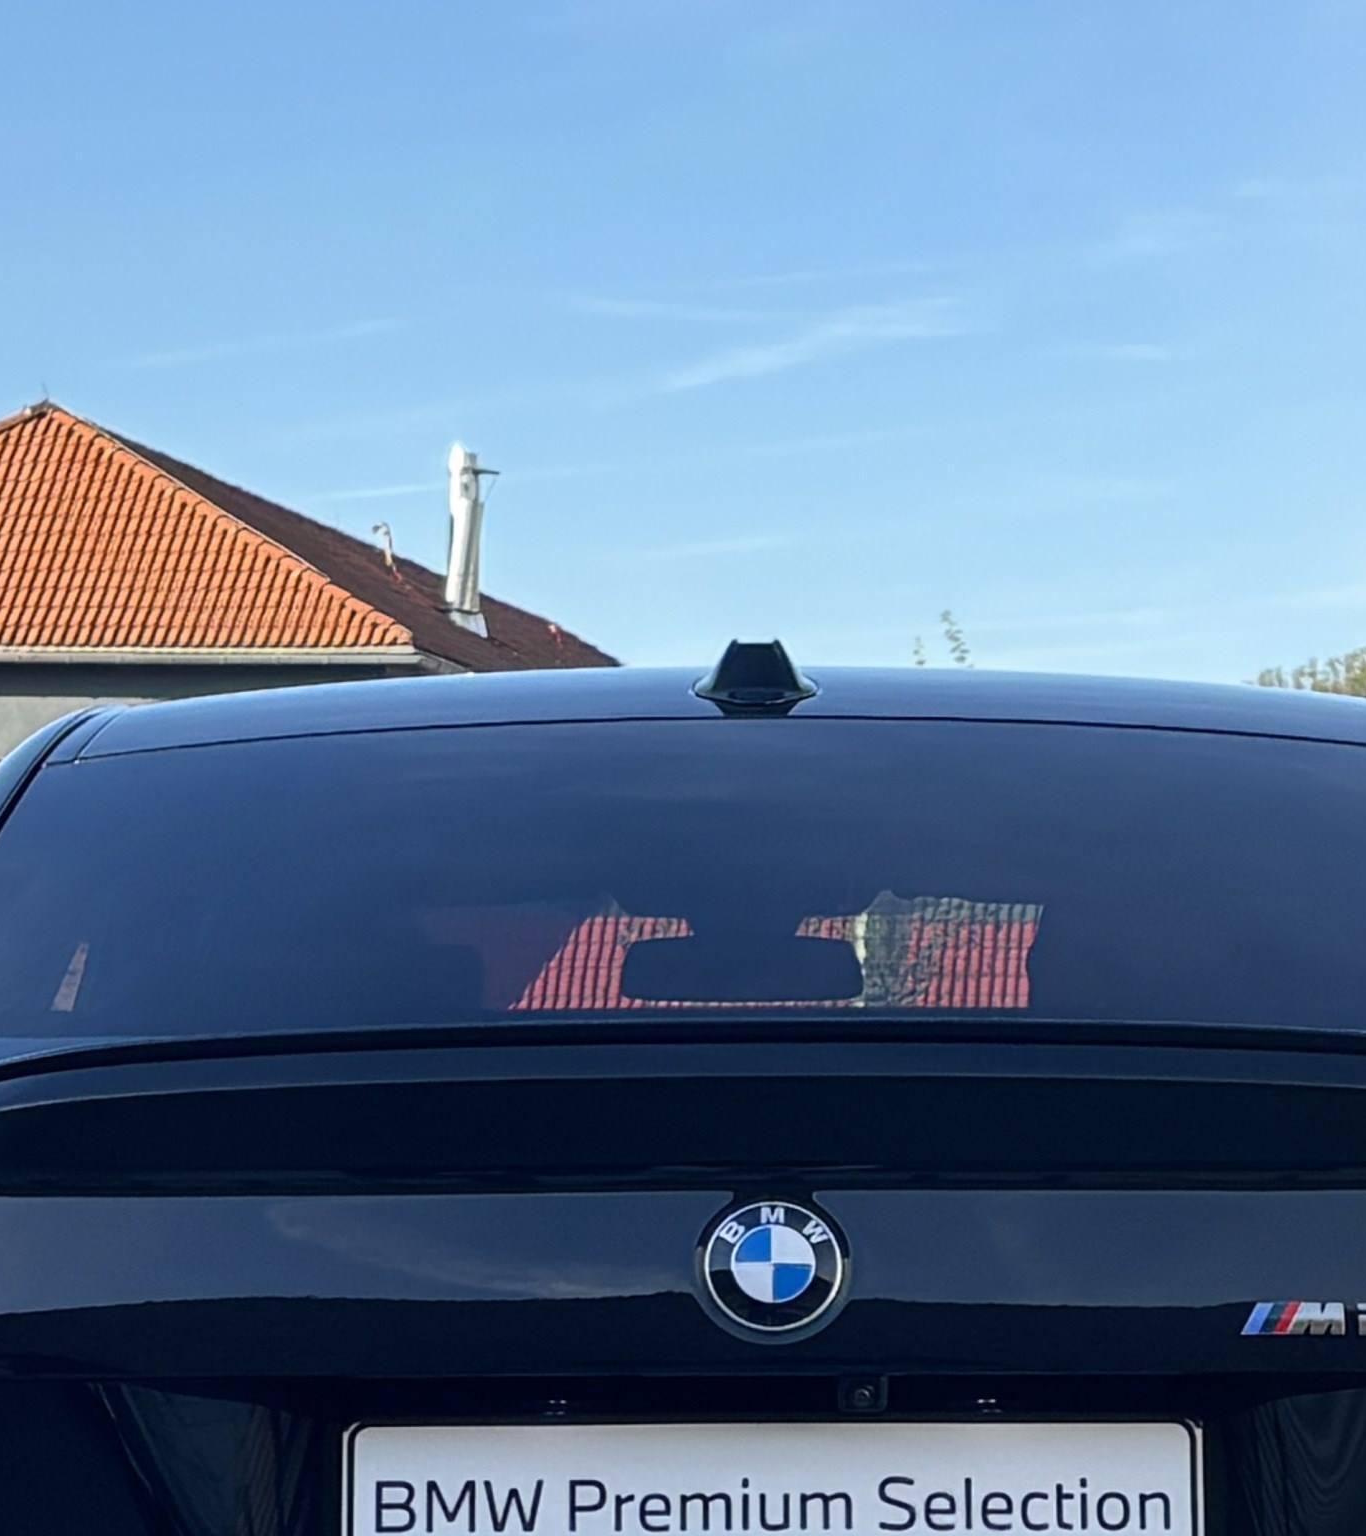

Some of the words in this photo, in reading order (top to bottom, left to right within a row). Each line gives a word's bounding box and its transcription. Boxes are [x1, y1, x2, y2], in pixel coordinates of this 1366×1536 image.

[719, 1207, 829, 1245] BMW
[374, 1480, 544, 1533] BMW
[568, 1477, 853, 1533] Premium
[878, 1476, 1171, 1532] Selection
